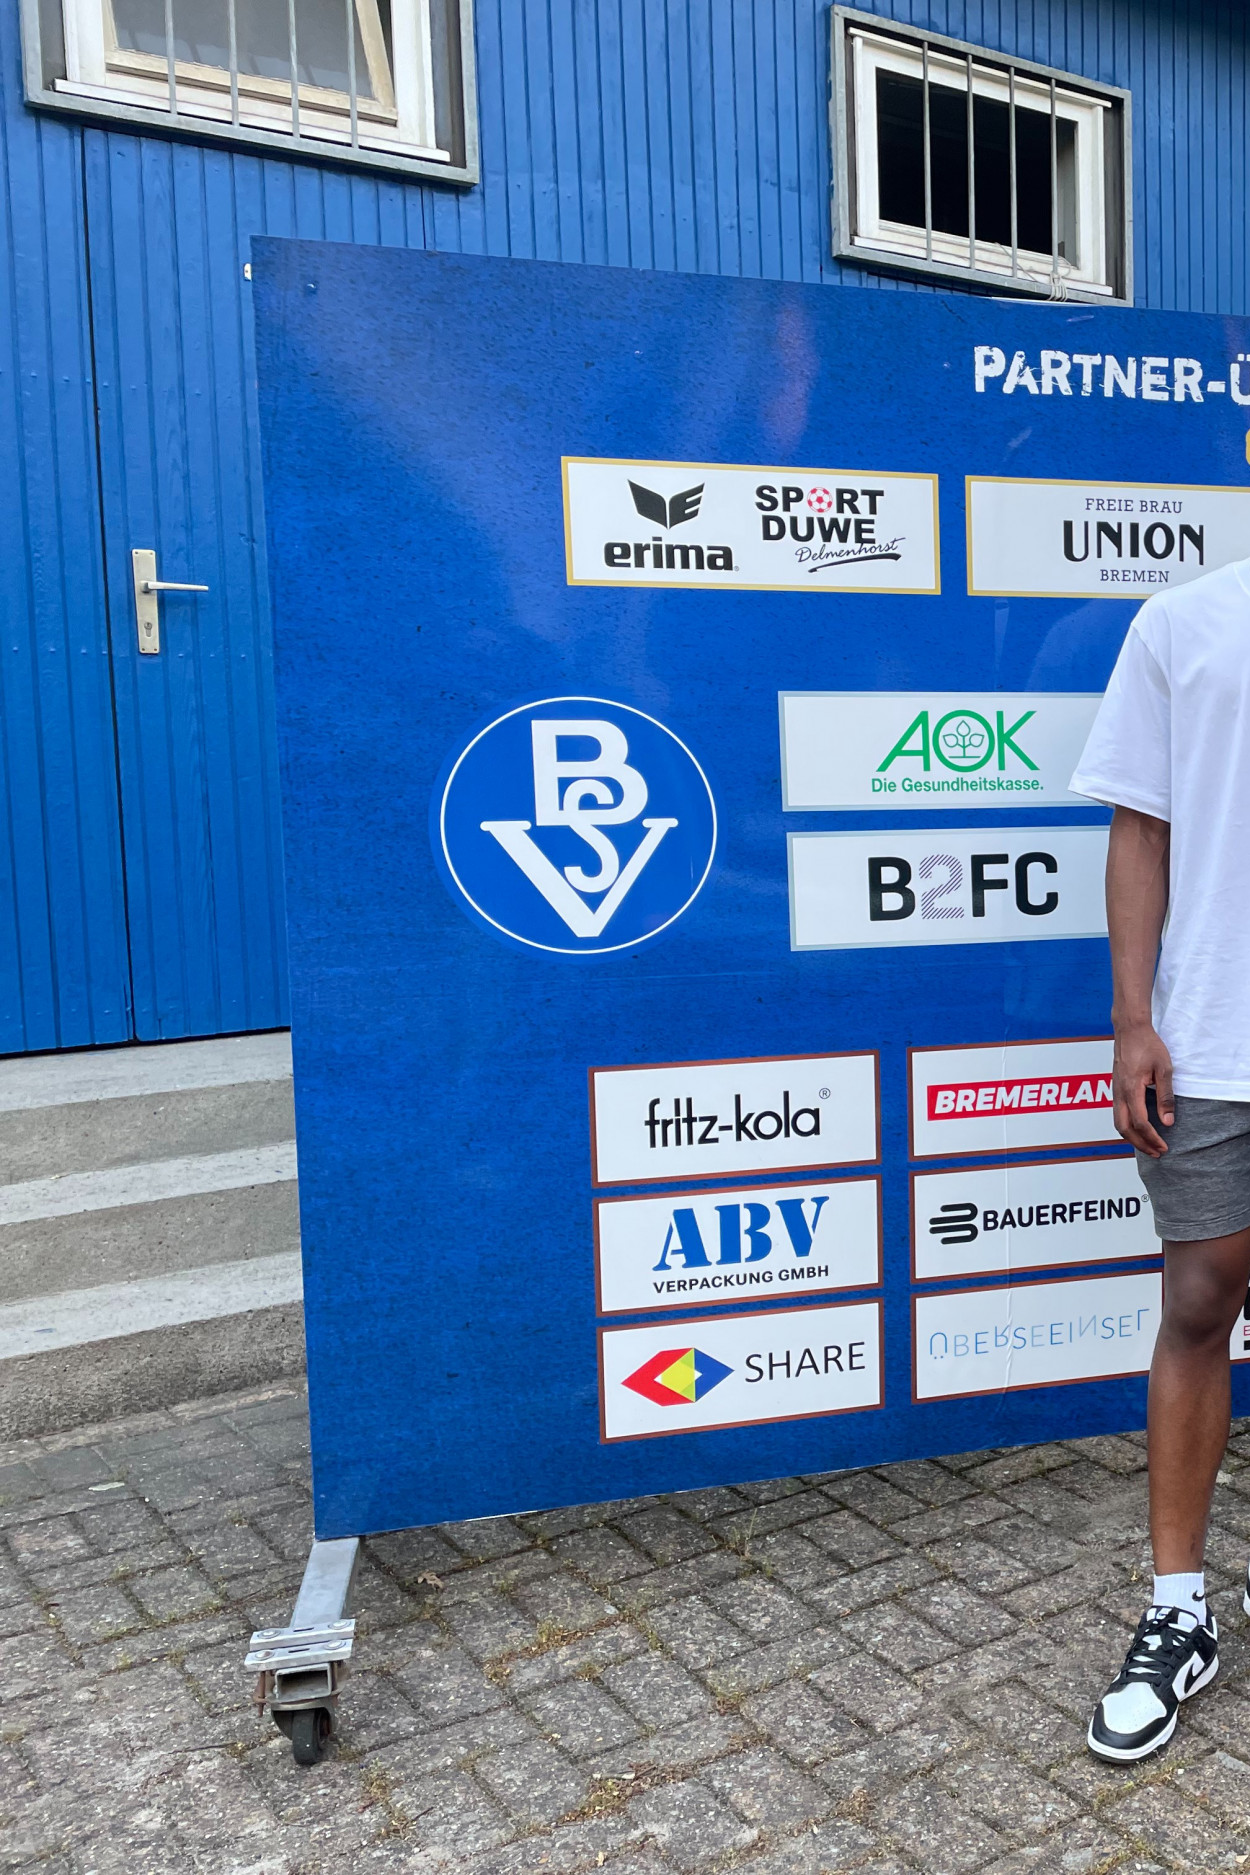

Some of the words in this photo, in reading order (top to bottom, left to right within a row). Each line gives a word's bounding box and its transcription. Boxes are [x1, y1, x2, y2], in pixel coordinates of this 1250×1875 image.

[755, 484, 884, 515] SPORT
[1085, 498, 1133, 512] FREIE
[1140, 500, 1182, 513] BRAU
[762, 514, 875, 544] DUWE
[1063, 520, 1204, 565] UNION
[604, 536, 733, 571] erima
[795, 537, 906, 563] Delmenhorst
[1100, 569, 1170, 583] BREMEN
[876, 709, 1040, 772] AOK
[871, 777, 897, 793] Die
[901, 777, 1044, 793] Gesundheitskasse.
[868, 851, 1058, 921] B2FC
[934, 1078, 1113, 1114] BREMERLAN
[983, 1196, 1141, 1231] BAUERFEIND
[652, 1196, 829, 1271] ABV
[653, 1270, 773, 1293] VERPACKUNG
[778, 1265, 829, 1281] GMBH
[745, 1342, 865, 1383] SHARE
